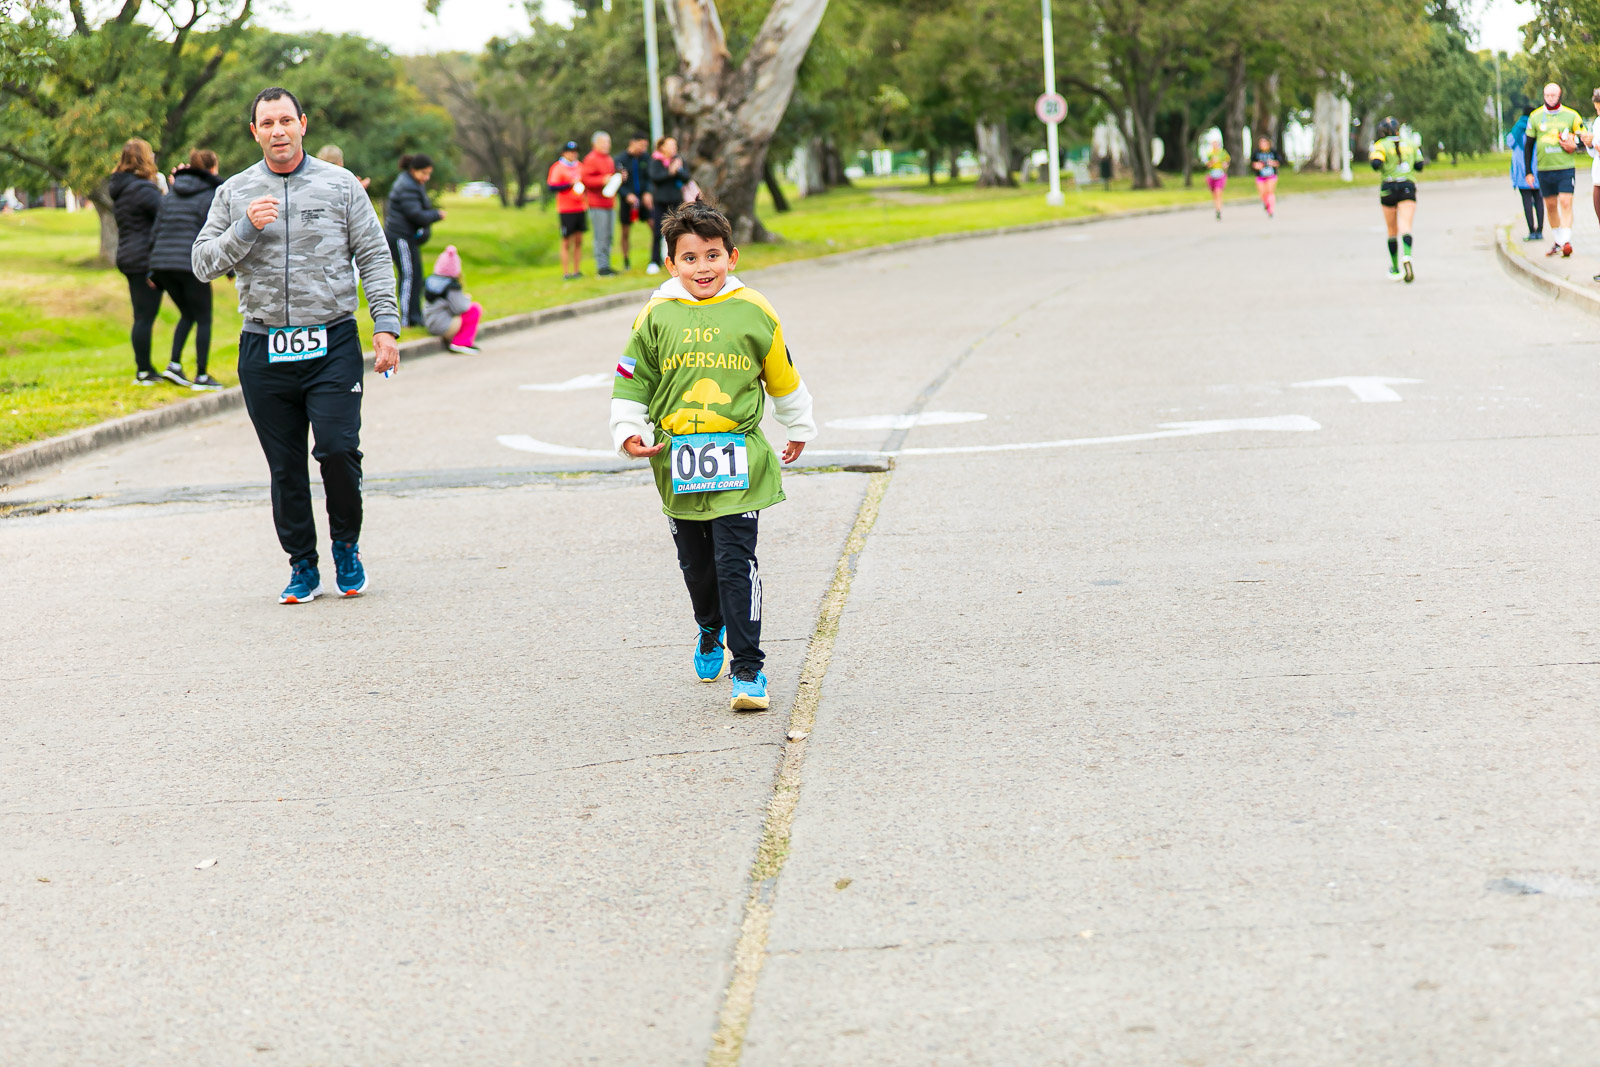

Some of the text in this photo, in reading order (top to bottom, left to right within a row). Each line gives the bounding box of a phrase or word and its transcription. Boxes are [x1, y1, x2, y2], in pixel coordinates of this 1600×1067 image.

[273, 327, 321, 354] 065
[682, 327, 720, 344] 216°
[676, 442, 736, 480] 061
[677, 480, 745, 491] DIAMANTE CORRE
